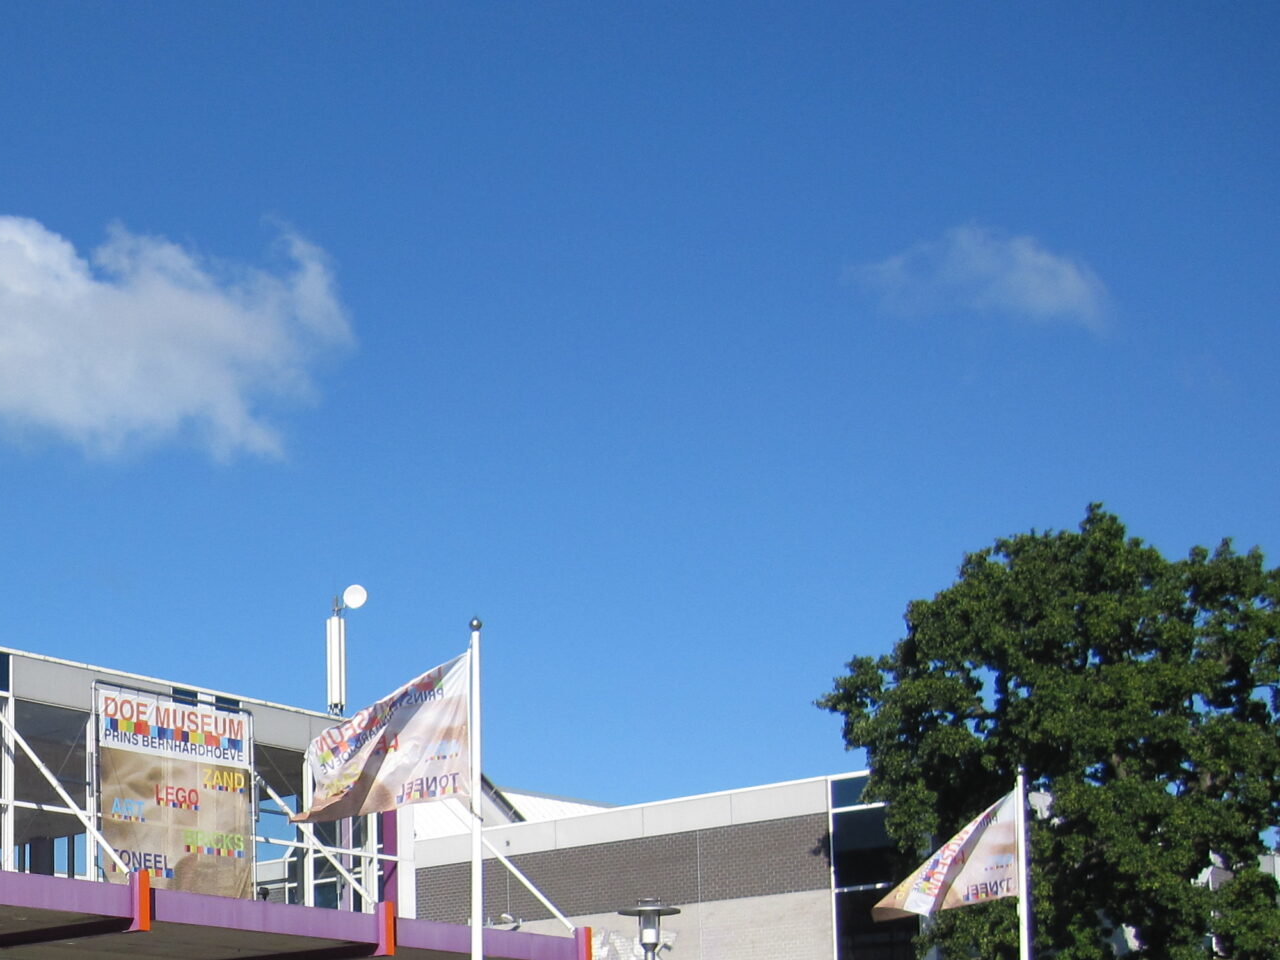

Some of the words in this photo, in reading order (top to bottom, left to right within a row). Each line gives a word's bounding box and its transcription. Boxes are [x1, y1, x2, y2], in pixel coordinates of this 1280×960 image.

[103, 696, 148, 722] DOE
[155, 705, 244, 740] MUSEUM
[104, 728, 139, 746] PRINS
[142, 735, 244, 762] BERNHARDHOEVE
[202, 768, 245, 789] ZAND
[111, 798, 145, 815] ART
[155, 784, 200, 807] LEGO
[183, 829, 244, 850] BRICKS
